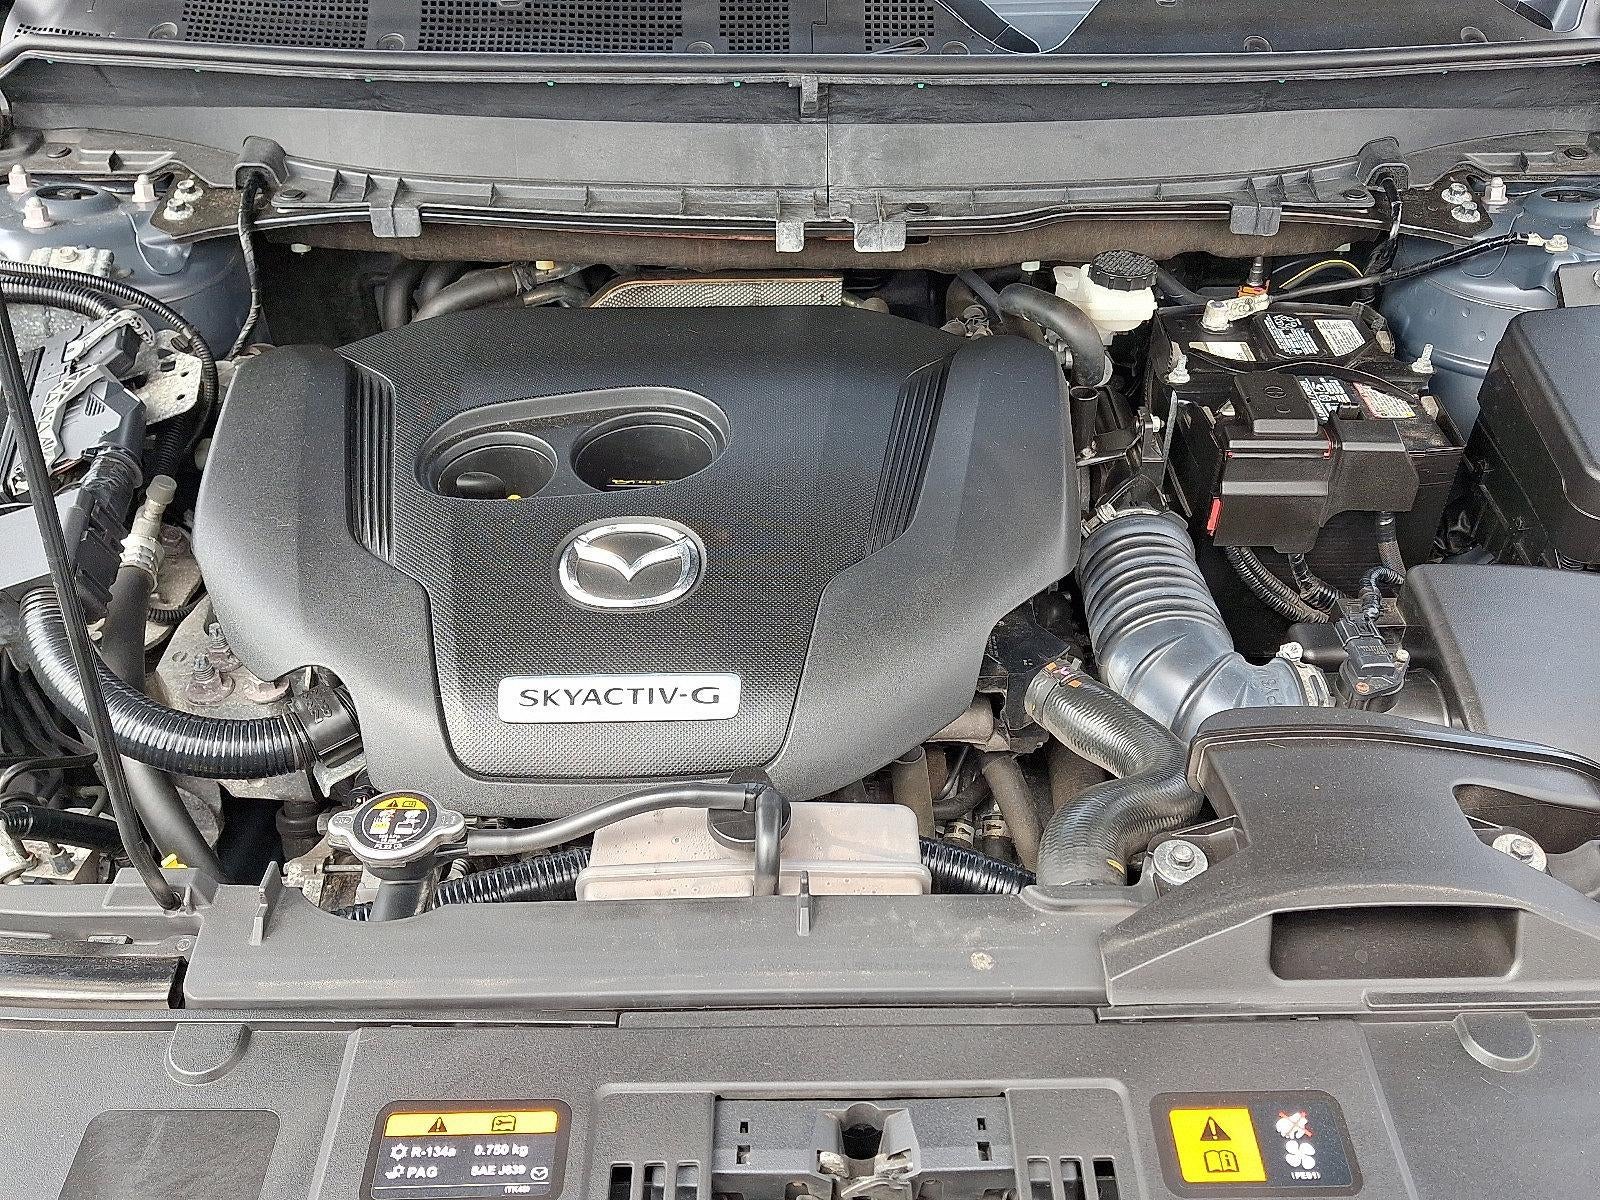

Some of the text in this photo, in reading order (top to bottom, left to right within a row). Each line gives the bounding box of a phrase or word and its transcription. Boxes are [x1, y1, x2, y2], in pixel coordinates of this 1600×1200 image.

[518, 686, 720, 707] SKYACTIV-G
[410, 1145, 457, 1158] R-134a
[511, 1142, 529, 1158] kg
[406, 1166, 438, 1179] PAG
[470, 1165, 497, 1177] SAE
